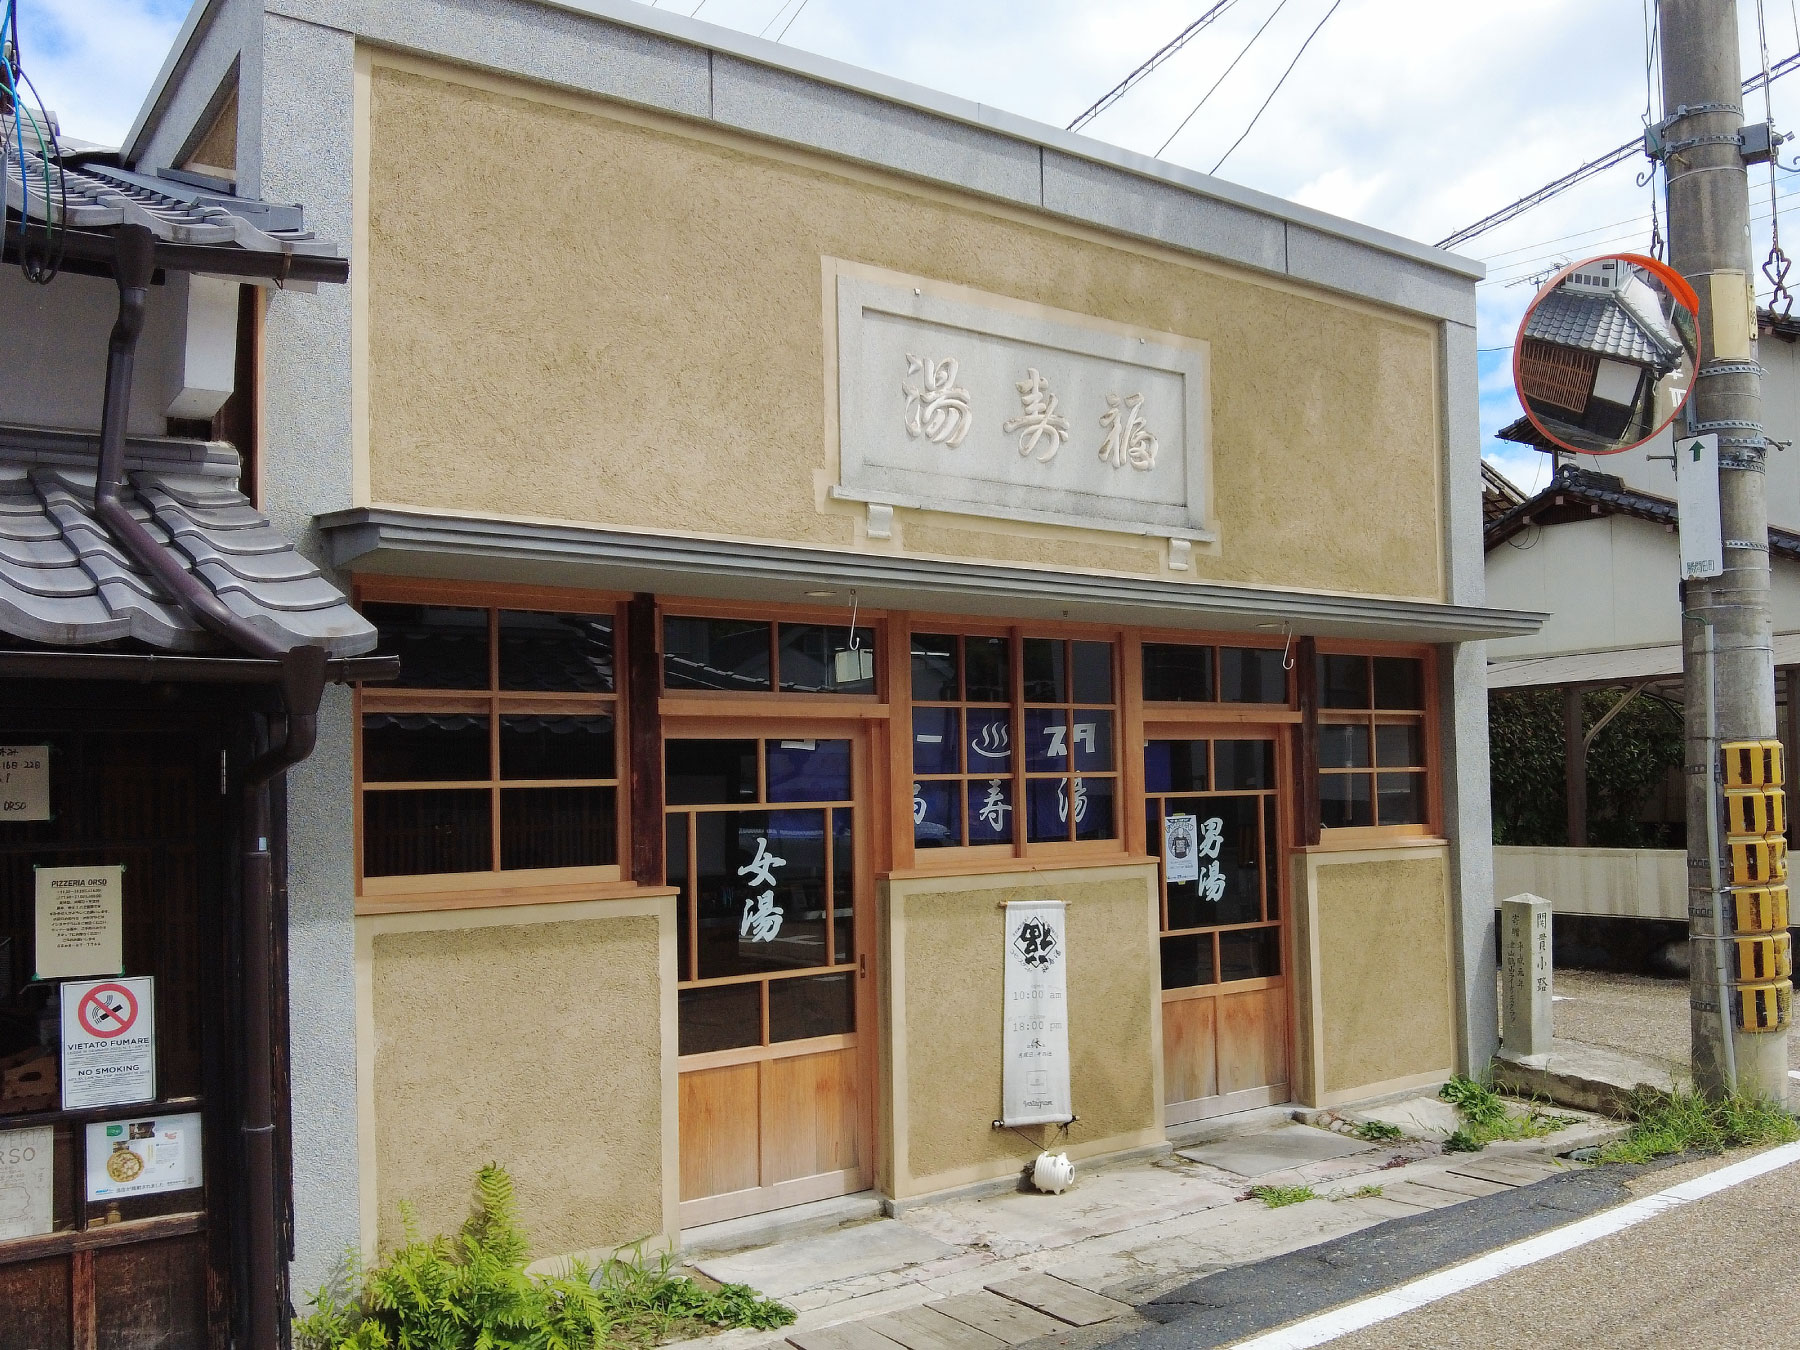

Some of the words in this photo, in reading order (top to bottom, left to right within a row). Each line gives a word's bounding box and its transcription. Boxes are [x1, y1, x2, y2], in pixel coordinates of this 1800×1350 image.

[4, 800, 26, 811] ORSO
[1198, 817, 1227, 902] 男湯
[51, 879, 86, 888] PIZZERIA
[87, 878, 108, 887] ORSO
[738, 837, 787, 943] 女湯
[1013, 990, 1044, 1001] 10:00
[1049, 991, 1062, 999] am
[1013, 1021, 1044, 1032] 18:00
[1049, 1022, 1063, 1032] pm
[67, 1041, 108, 1051] VIETATO
[110, 1037, 150, 1047] FUMARE
[78, 1069, 93, 1077] NO
[95, 1064, 140, 1075] SMOKING
